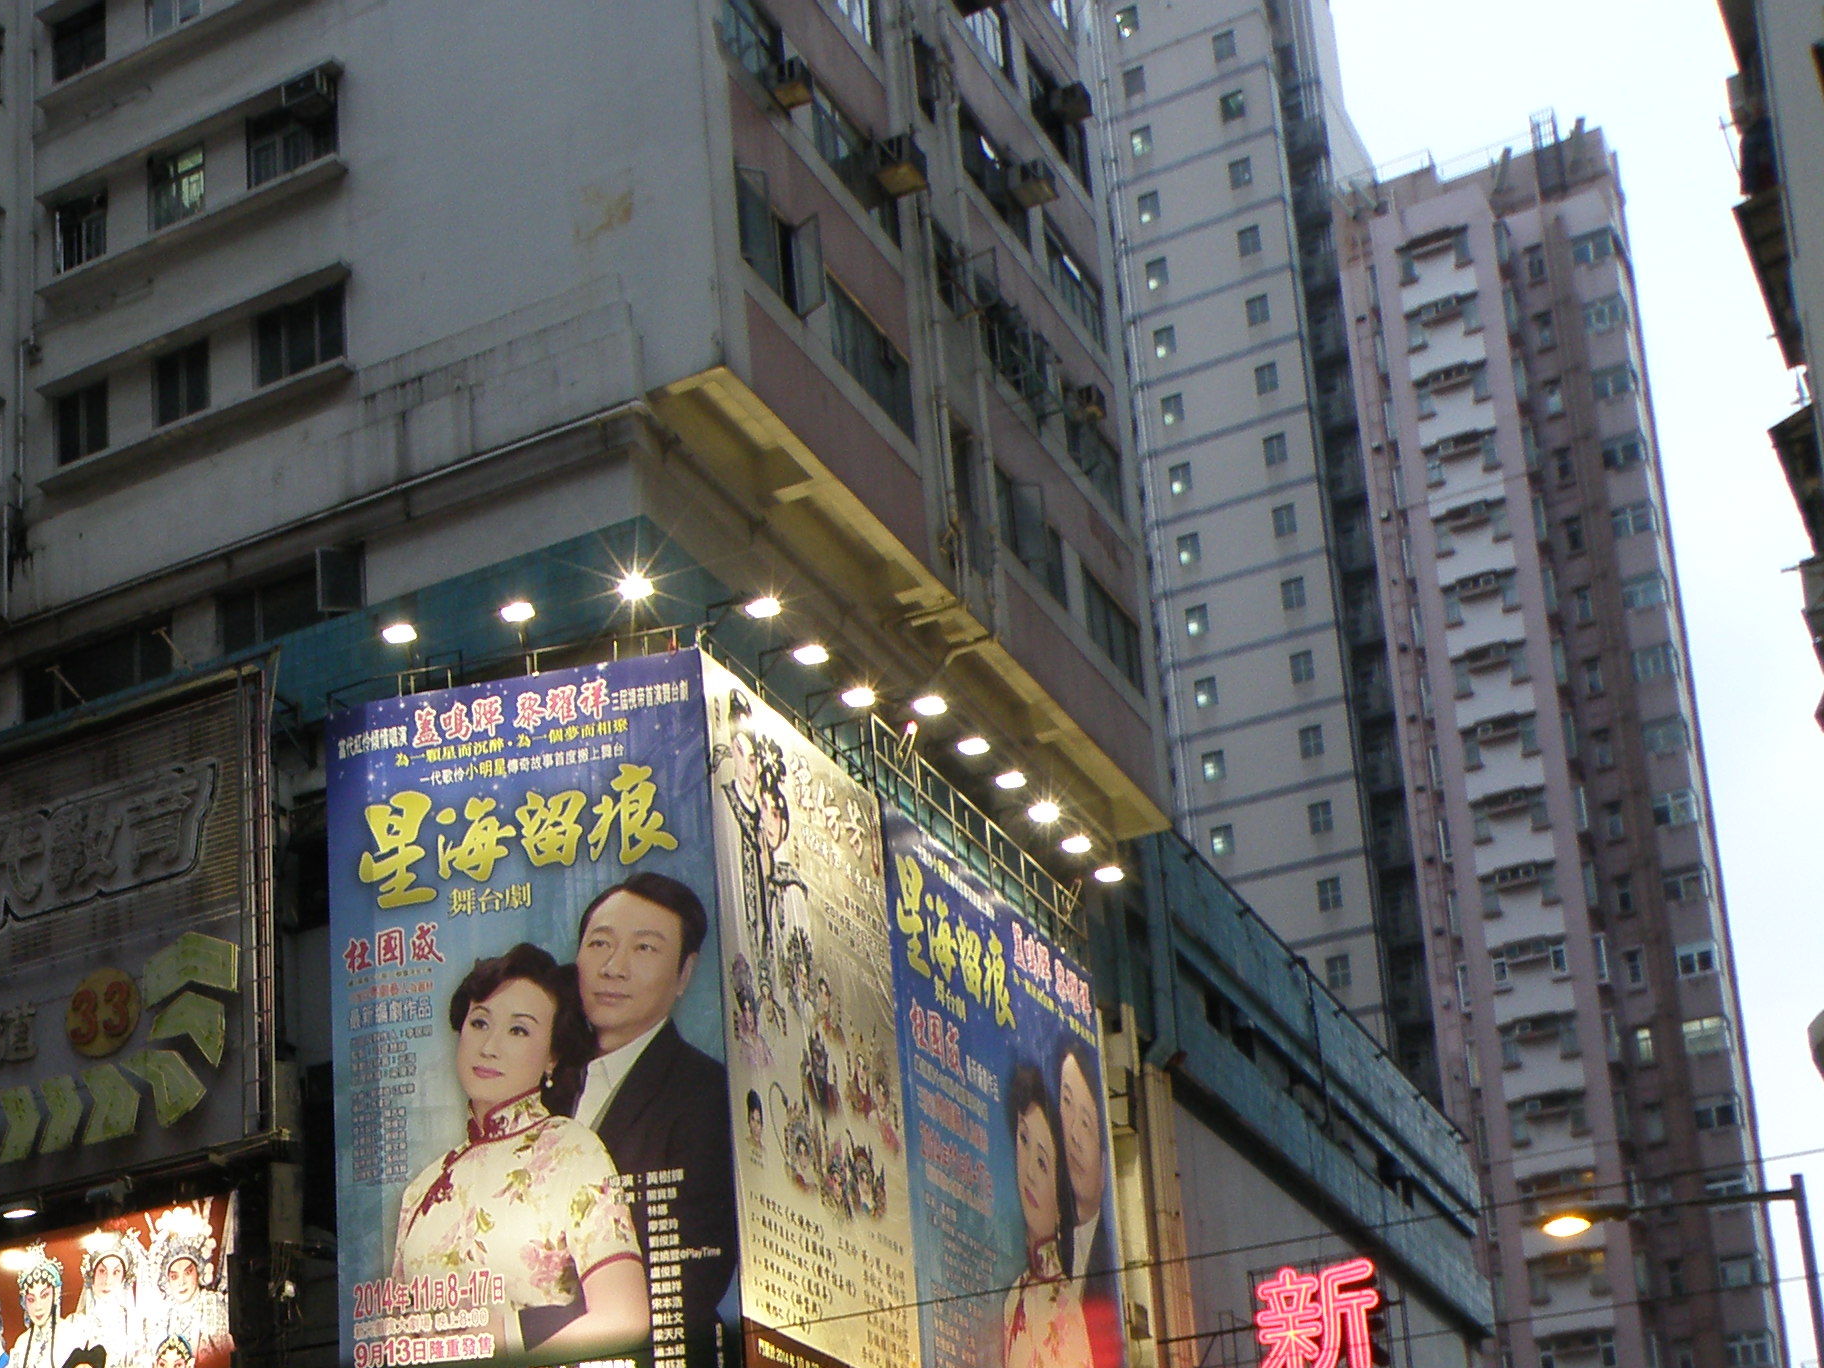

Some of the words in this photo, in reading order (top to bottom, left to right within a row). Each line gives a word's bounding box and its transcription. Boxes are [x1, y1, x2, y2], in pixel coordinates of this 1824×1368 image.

[412, 696, 504, 747] 蓋鳴暉
[512, 678, 610, 731] 黎耀祥
[358, 762, 679, 910] 星海留痕
[447, 882, 532, 918] 舞台劇
[343, 922, 445, 974] 杜國威
[895, 854, 1016, 1029] 星海留痕
[69, 980, 133, 1045] 33
[354, 1268, 506, 1320] 2014年11月8-17日
